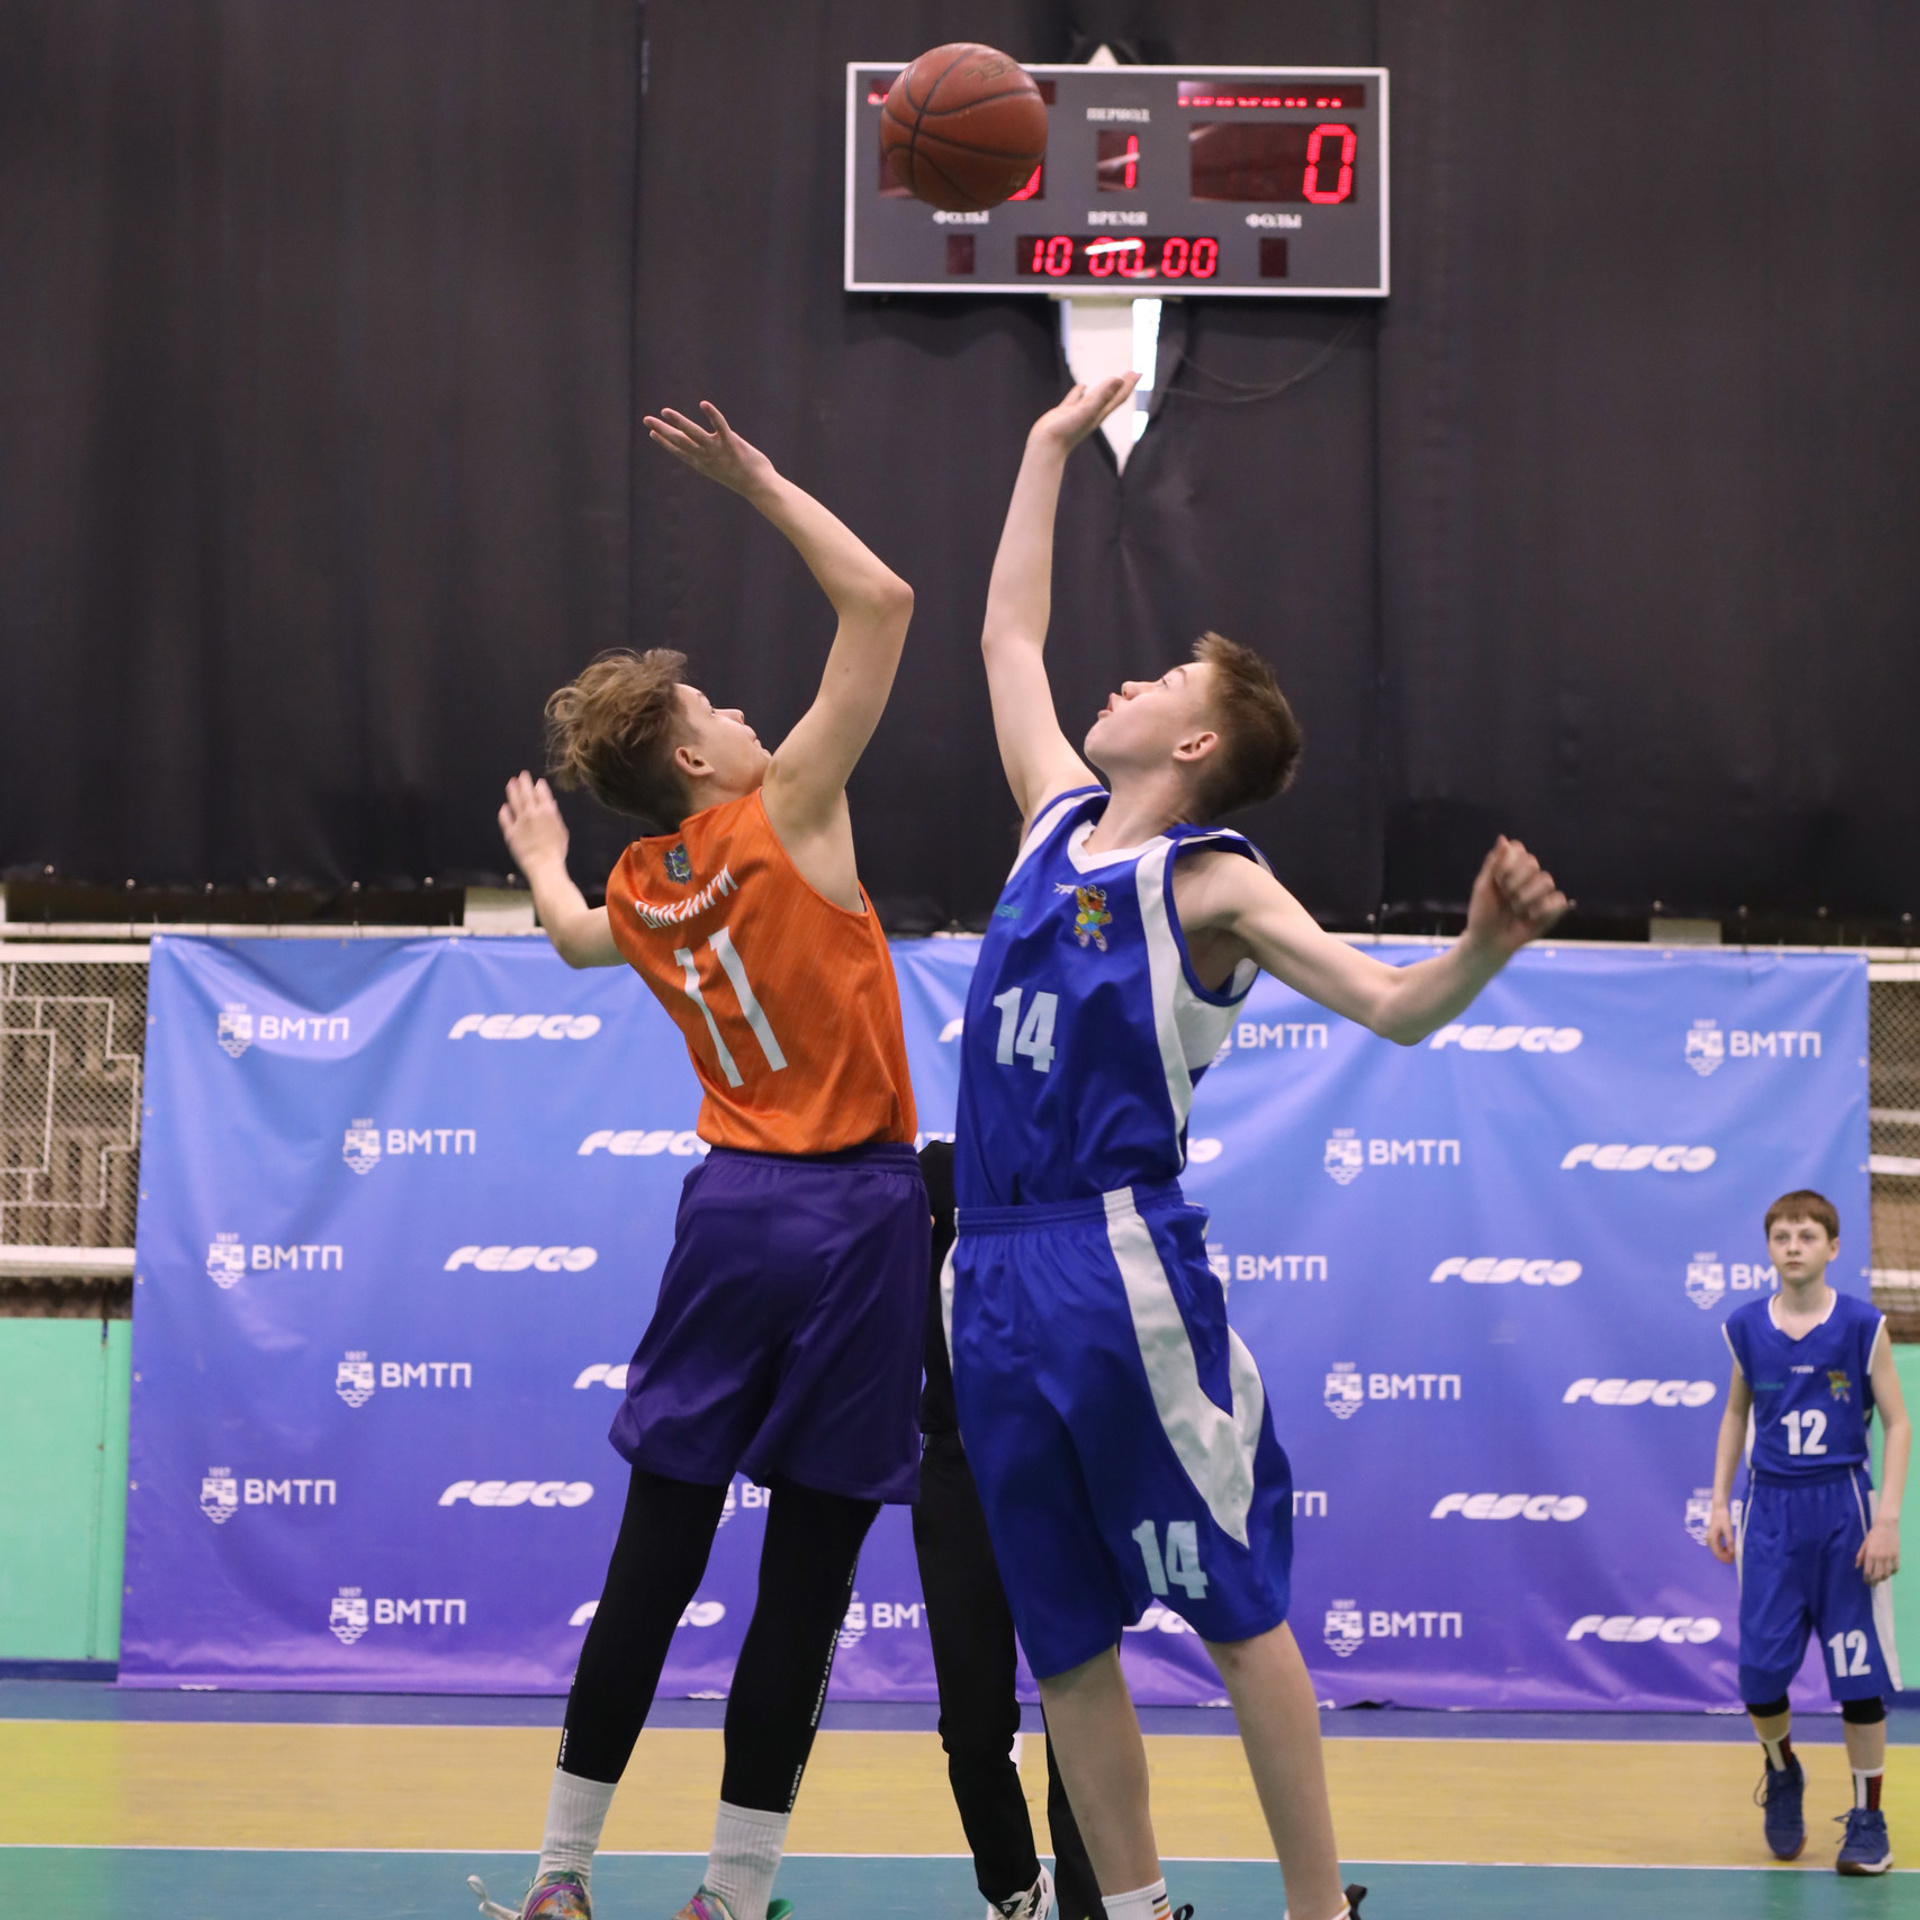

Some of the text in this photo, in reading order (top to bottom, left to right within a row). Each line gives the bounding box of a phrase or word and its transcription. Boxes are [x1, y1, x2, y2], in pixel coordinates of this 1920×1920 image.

[1086, 107, 1151, 122] ПЕРИОД
[1124, 135, 1139, 190] 1
[1302, 124, 1357, 205] 0
[1088, 211, 1148, 226] ВРЕМЯ
[1246, 214, 1302, 229] ФОЛЫ
[635, 864, 738, 929] ВИКИНГИ
[674, 926, 788, 1088] 11
[259, 1016, 349, 1041] ВМТП
[449, 1014, 600, 1039] FESCO
[993, 987, 1058, 1073] 14
[1238, 1023, 1327, 1050] ВМТП
[1430, 1025, 1582, 1053] FESCO
[1730, 1031, 1820, 1057] ВМТП
[387, 1129, 476, 1154] ВМТП
[578, 1131, 708, 1155] FESC
[1369, 1139, 1459, 1165] ВМТП
[1561, 1144, 1715, 1171] FESCO
[252, 1245, 342, 1270] ВМТП
[444, 1246, 597, 1271] FESCO
[1237, 1256, 1327, 1280] ВМТП
[1431, 1258, 1581, 1285] FESCO
[1731, 1264, 1777, 1289] ВМ
[382, 1363, 471, 1387] ВМТП
[1369, 1374, 1460, 1399] ВМТП
[1563, 1378, 1715, 1406] FESCO
[1780, 1409, 1828, 1455] 12
[245, 1479, 336, 1504] ВМТП
[439, 1481, 593, 1506] FESCO
[1431, 1493, 1587, 1521] FESCO
[1131, 1519, 1207, 1599] 14
[375, 1599, 466, 1624] ВМТП
[872, 1603, 919, 1628] ВМ
[1370, 1611, 1461, 1637] ВМТП
[1567, 1616, 1721, 1643] FESCO
[1828, 1629, 1871, 1677] 12
